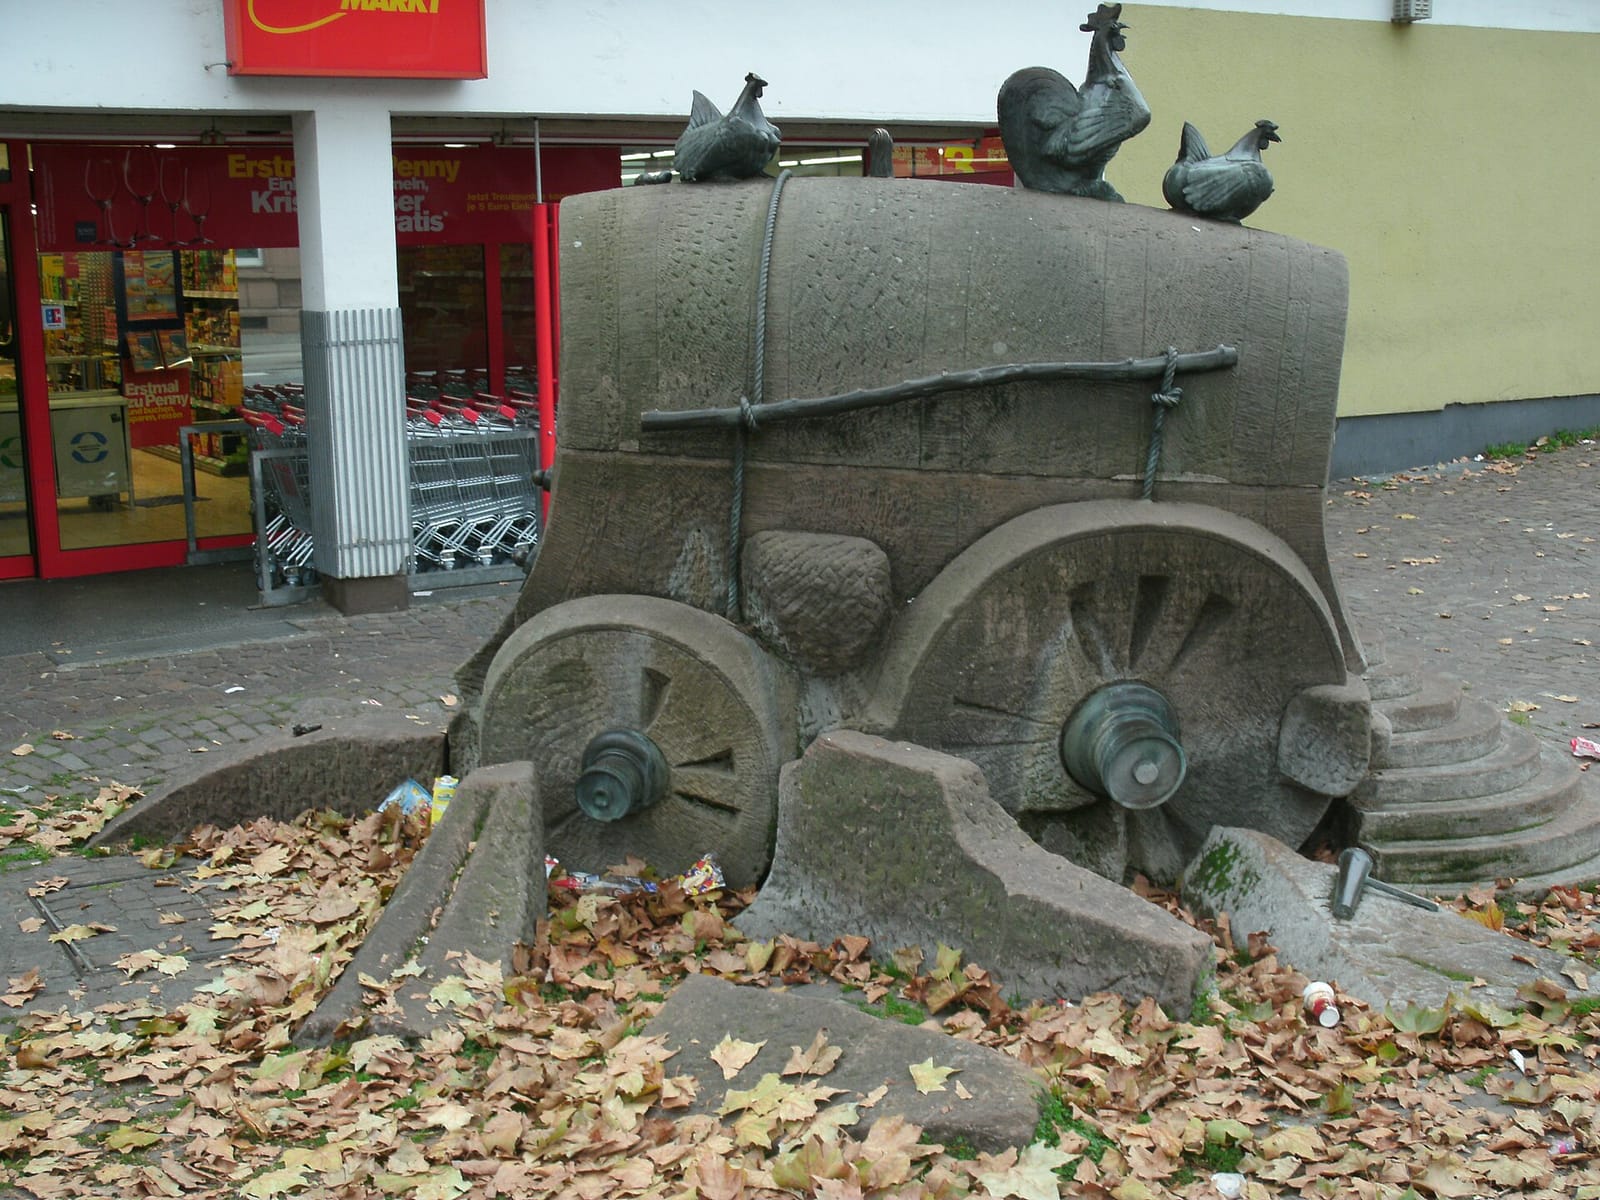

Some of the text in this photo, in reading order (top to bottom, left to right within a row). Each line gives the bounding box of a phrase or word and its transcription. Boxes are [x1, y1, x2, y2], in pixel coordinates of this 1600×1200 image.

[228, 154, 295, 178] Erst
[394, 194, 425, 212] er
[125, 379, 179, 396] Erstmal
[145, 394, 190, 408] Penny
